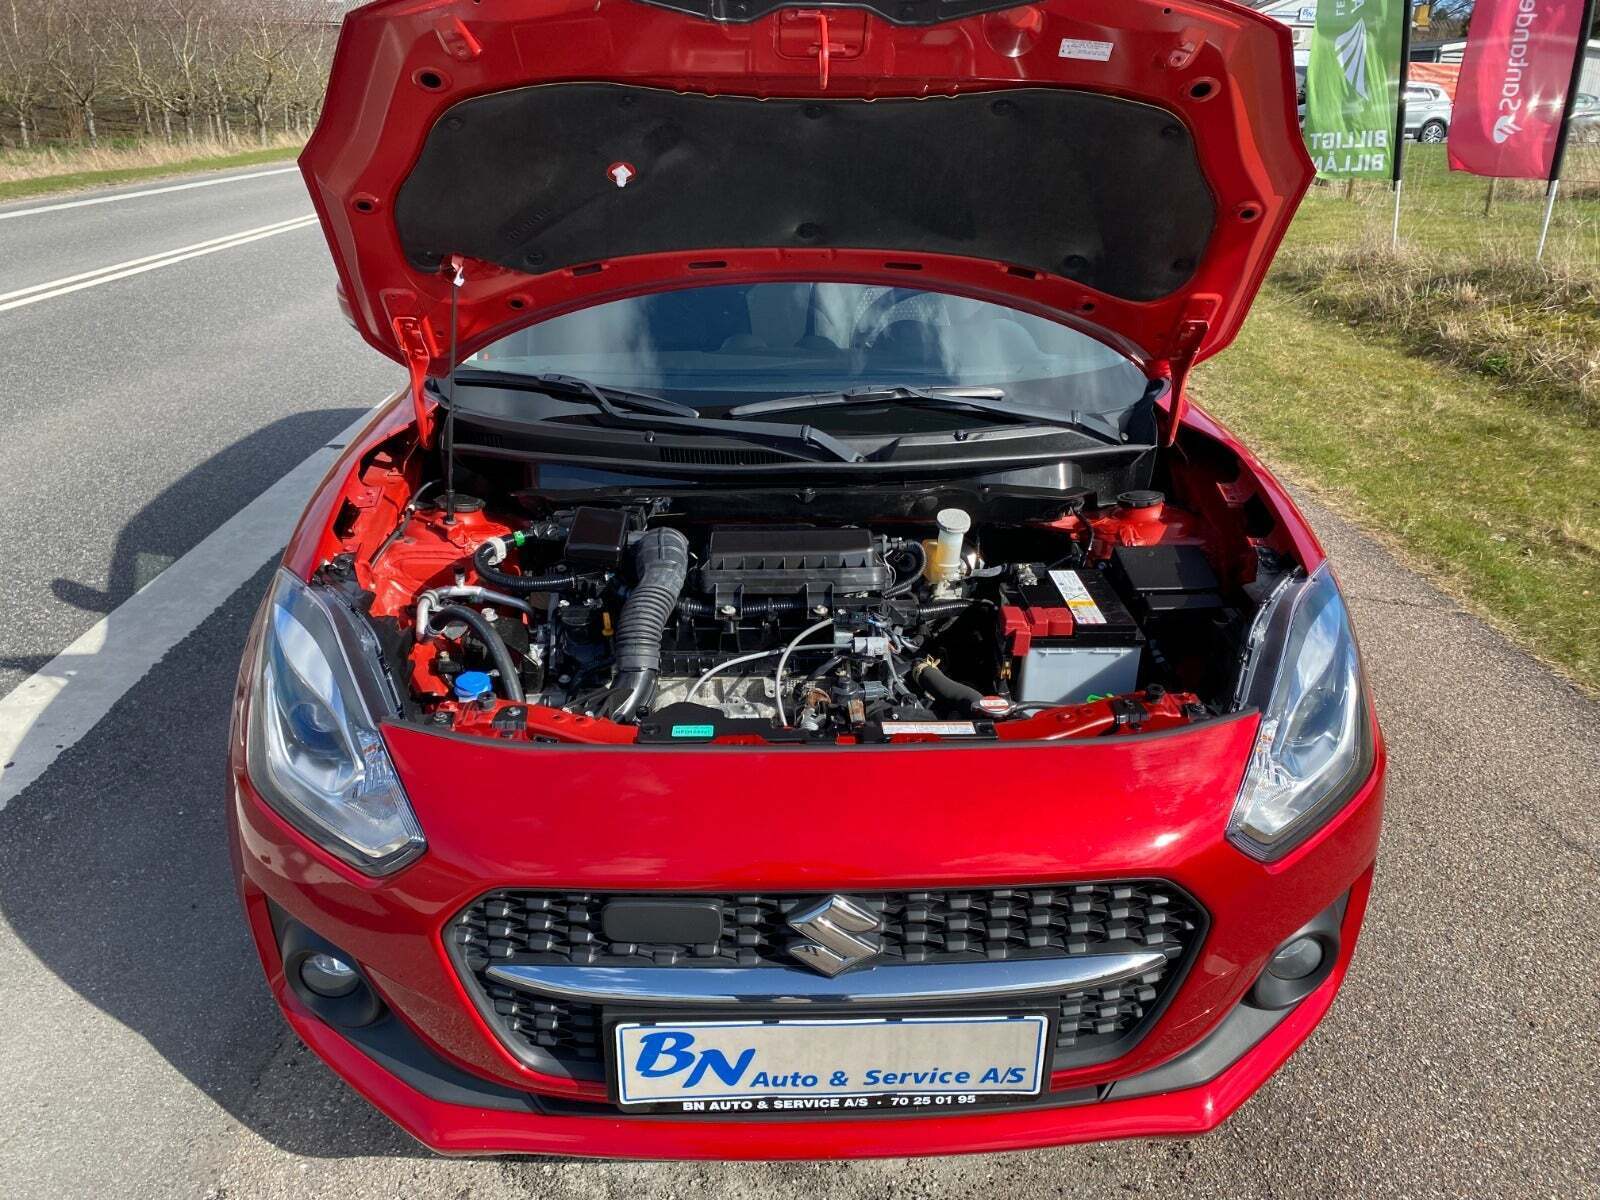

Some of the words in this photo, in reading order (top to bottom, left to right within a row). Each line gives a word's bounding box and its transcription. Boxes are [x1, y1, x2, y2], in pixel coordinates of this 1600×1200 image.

[635, 1031, 756, 1088] BN
[750, 1071, 818, 1088] Auto
[829, 1070, 849, 1087] &
[863, 1067, 971, 1086] Service
[979, 1067, 1026, 1084] A/S
[683, 1101, 705, 1111] BN
[709, 1099, 753, 1111] AUTO
[757, 1099, 769, 1110] &
[775, 1098, 840, 1110] SERVICE
[844, 1098, 869, 1108] A/S
[891, 1097, 909, 1107] 70
[913, 1096, 932, 1105] 25
[935, 1096, 953, 1105] 01
[957, 1094, 976, 1104] 95
